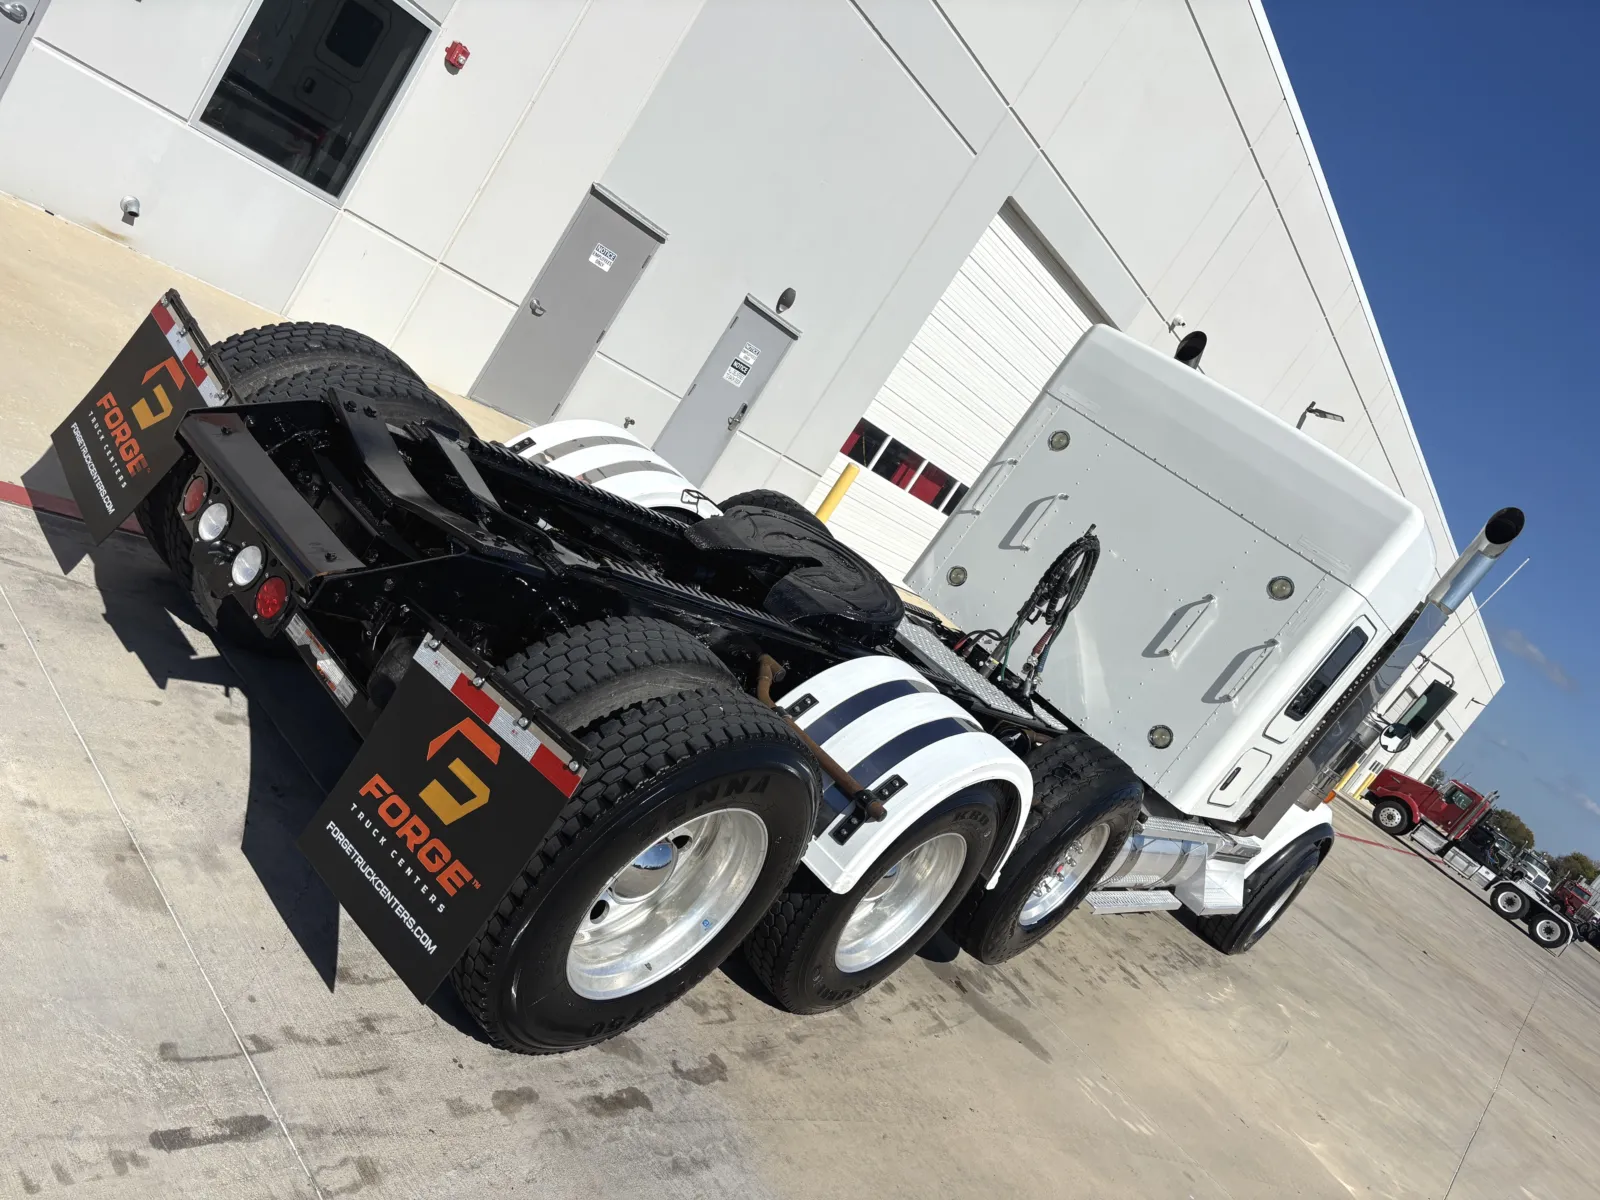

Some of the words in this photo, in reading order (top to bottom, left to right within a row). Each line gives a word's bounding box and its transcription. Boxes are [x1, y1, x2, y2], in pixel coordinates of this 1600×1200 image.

[596, 243, 617, 261] NOTICE
[732, 360, 749, 374] NOTICE
[70, 422, 115, 515] FORGETRUCKCENTERS.COM
[88, 410, 105, 441] TRUCK
[103, 444, 127, 489] CENTERS
[96, 391, 149, 477] FORGE
[350, 802, 387, 846] TRUCK
[390, 849, 446, 914] CENTERS
[358, 773, 473, 897] FORGE
[325, 820, 437, 955] FORGETRUCKCENTERS.COM
